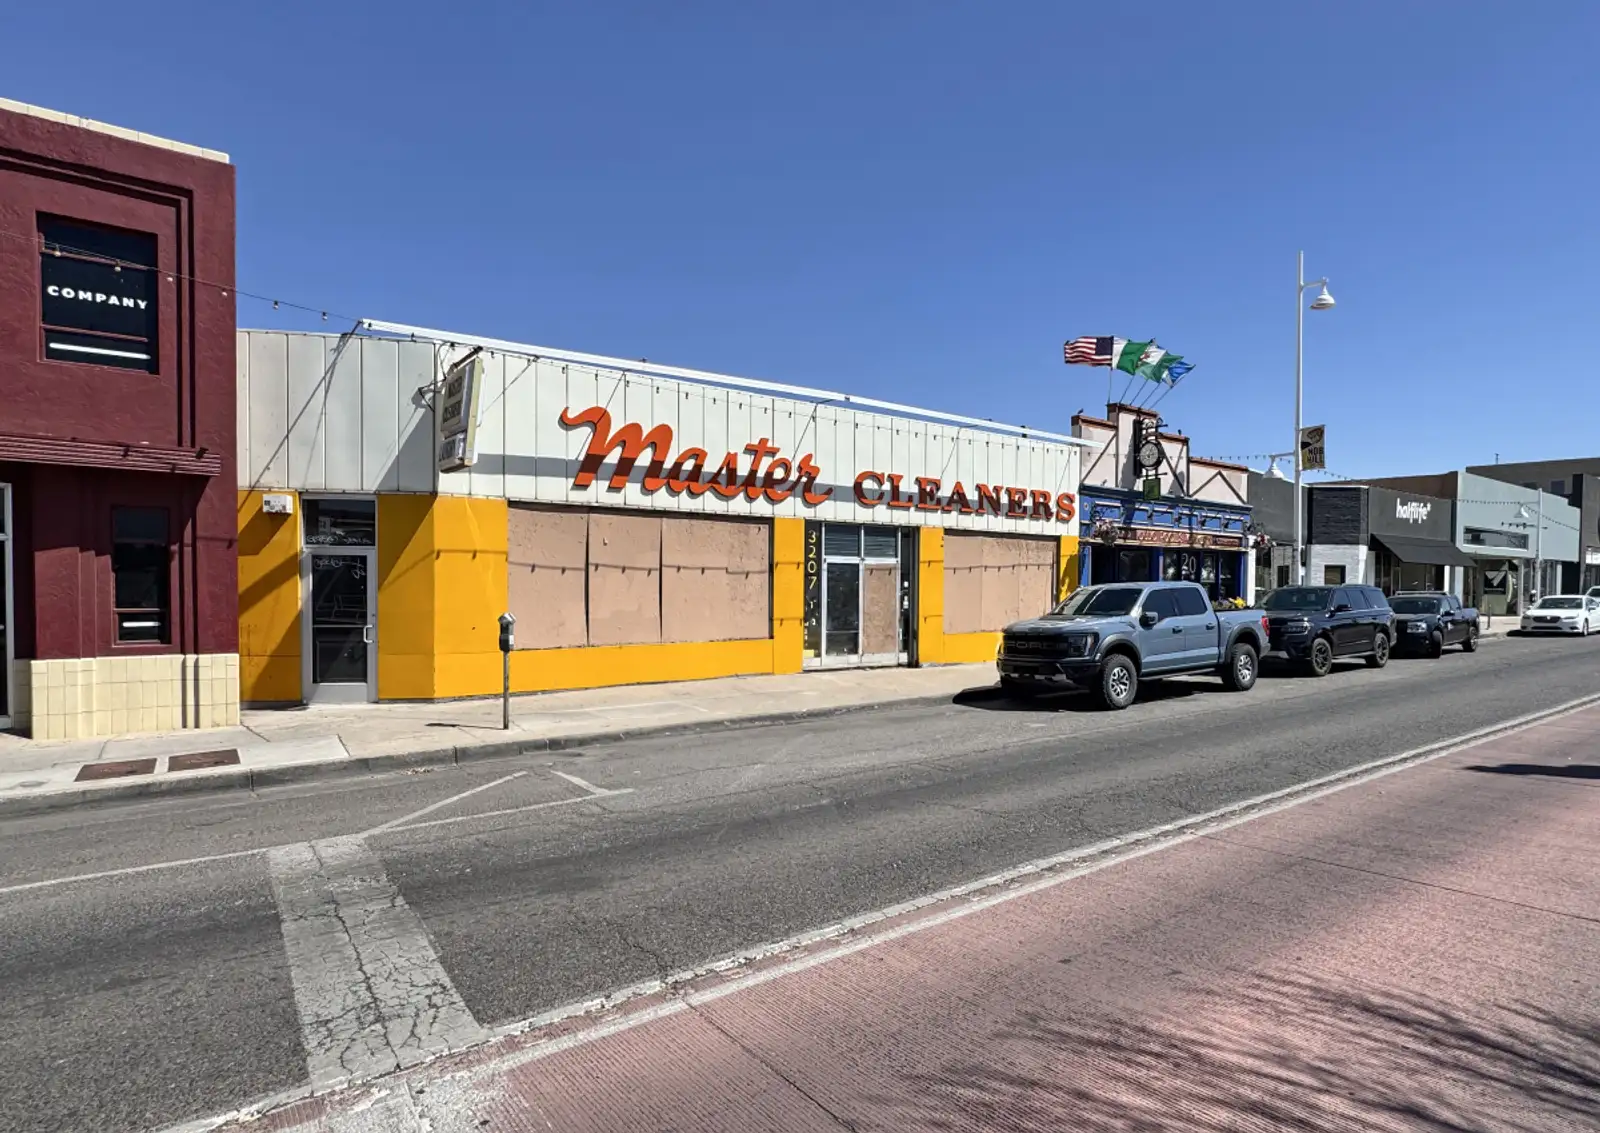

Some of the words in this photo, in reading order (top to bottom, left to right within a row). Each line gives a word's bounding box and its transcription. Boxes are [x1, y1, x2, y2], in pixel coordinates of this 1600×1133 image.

[47, 285, 148, 310] COMPANY
[559, 406, 833, 505] Master
[853, 470, 1076, 522] CLEANERS
